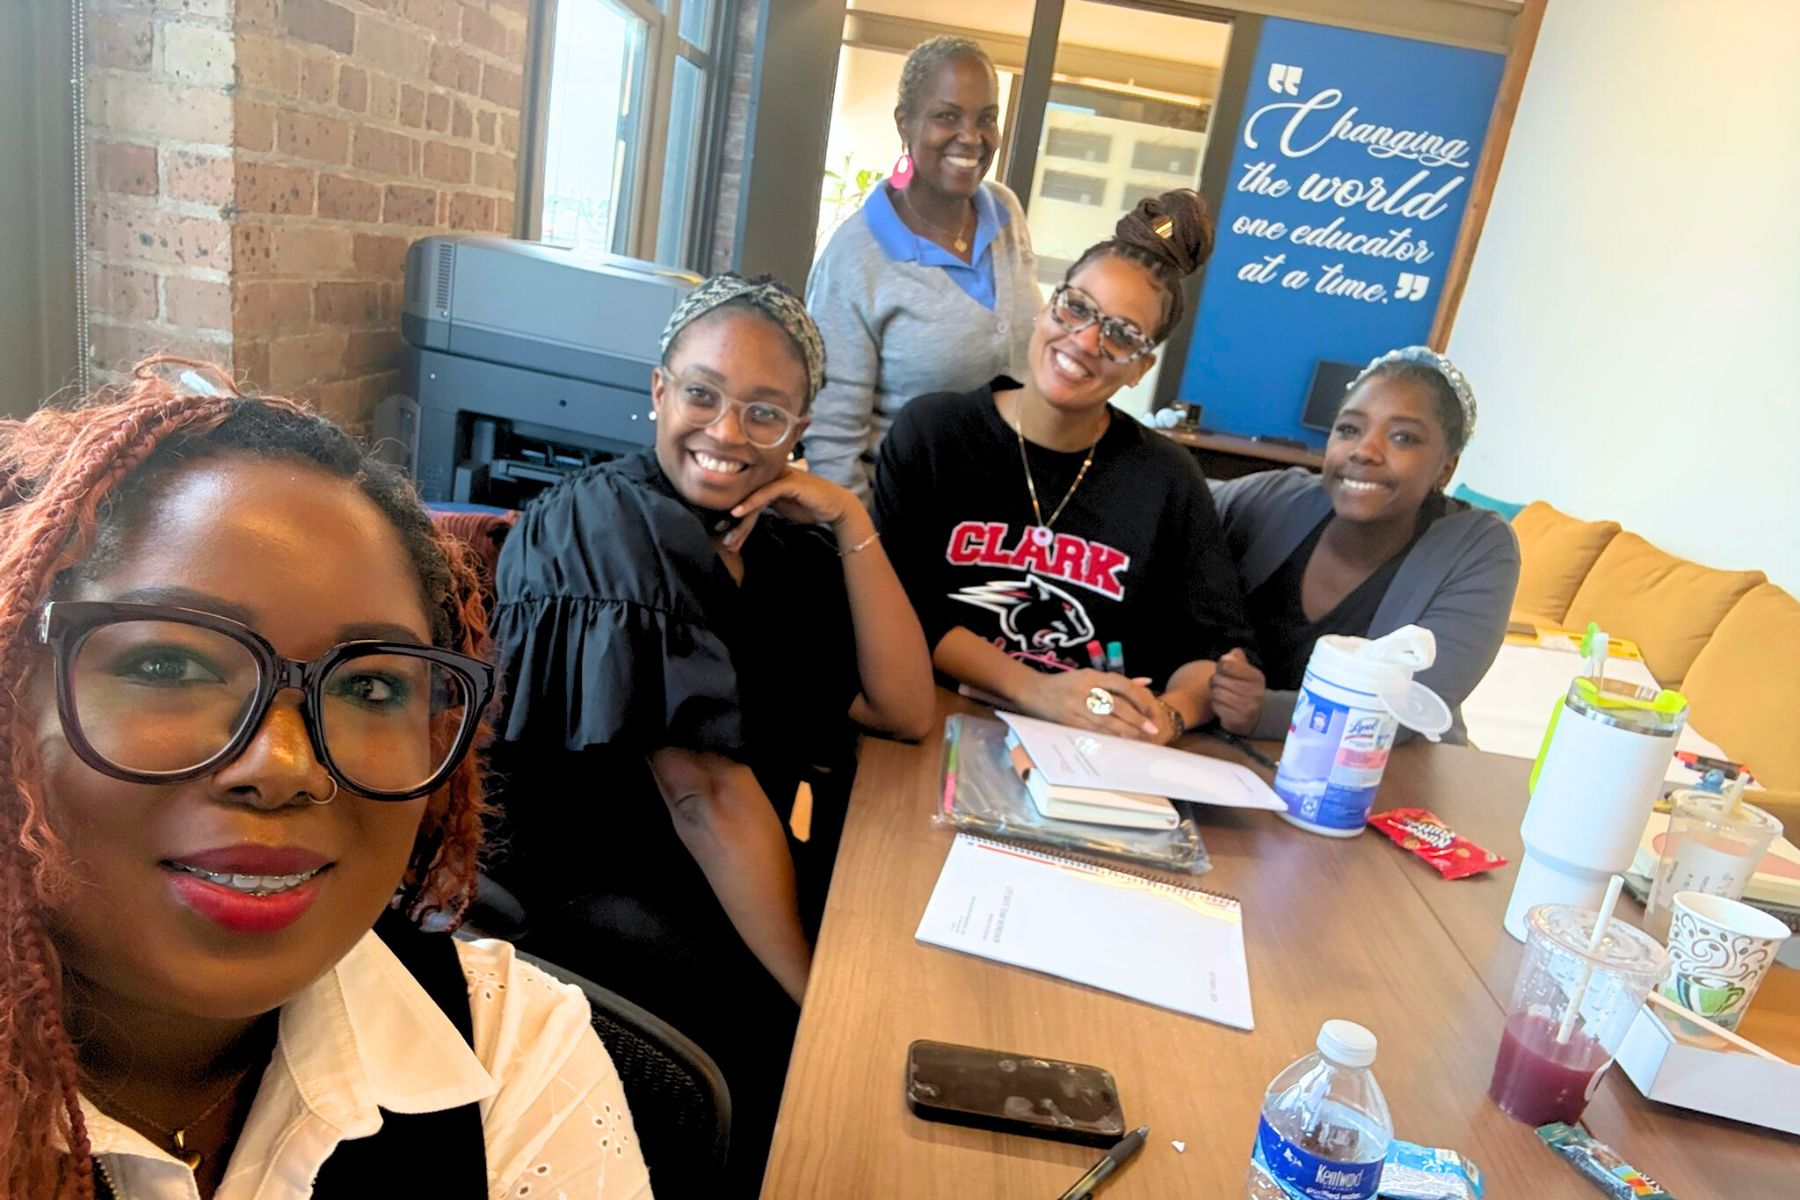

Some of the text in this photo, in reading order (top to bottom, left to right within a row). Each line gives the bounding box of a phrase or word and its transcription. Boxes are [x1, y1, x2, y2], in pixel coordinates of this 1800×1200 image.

[1243, 88, 1471, 168] Changing
[1237, 161, 1466, 221] the world
[1232, 215, 1434, 264] one educator
[1237, 253, 1287, 284] at
[1281, 269, 1311, 290] a
[945, 521, 1130, 602] CLARK
